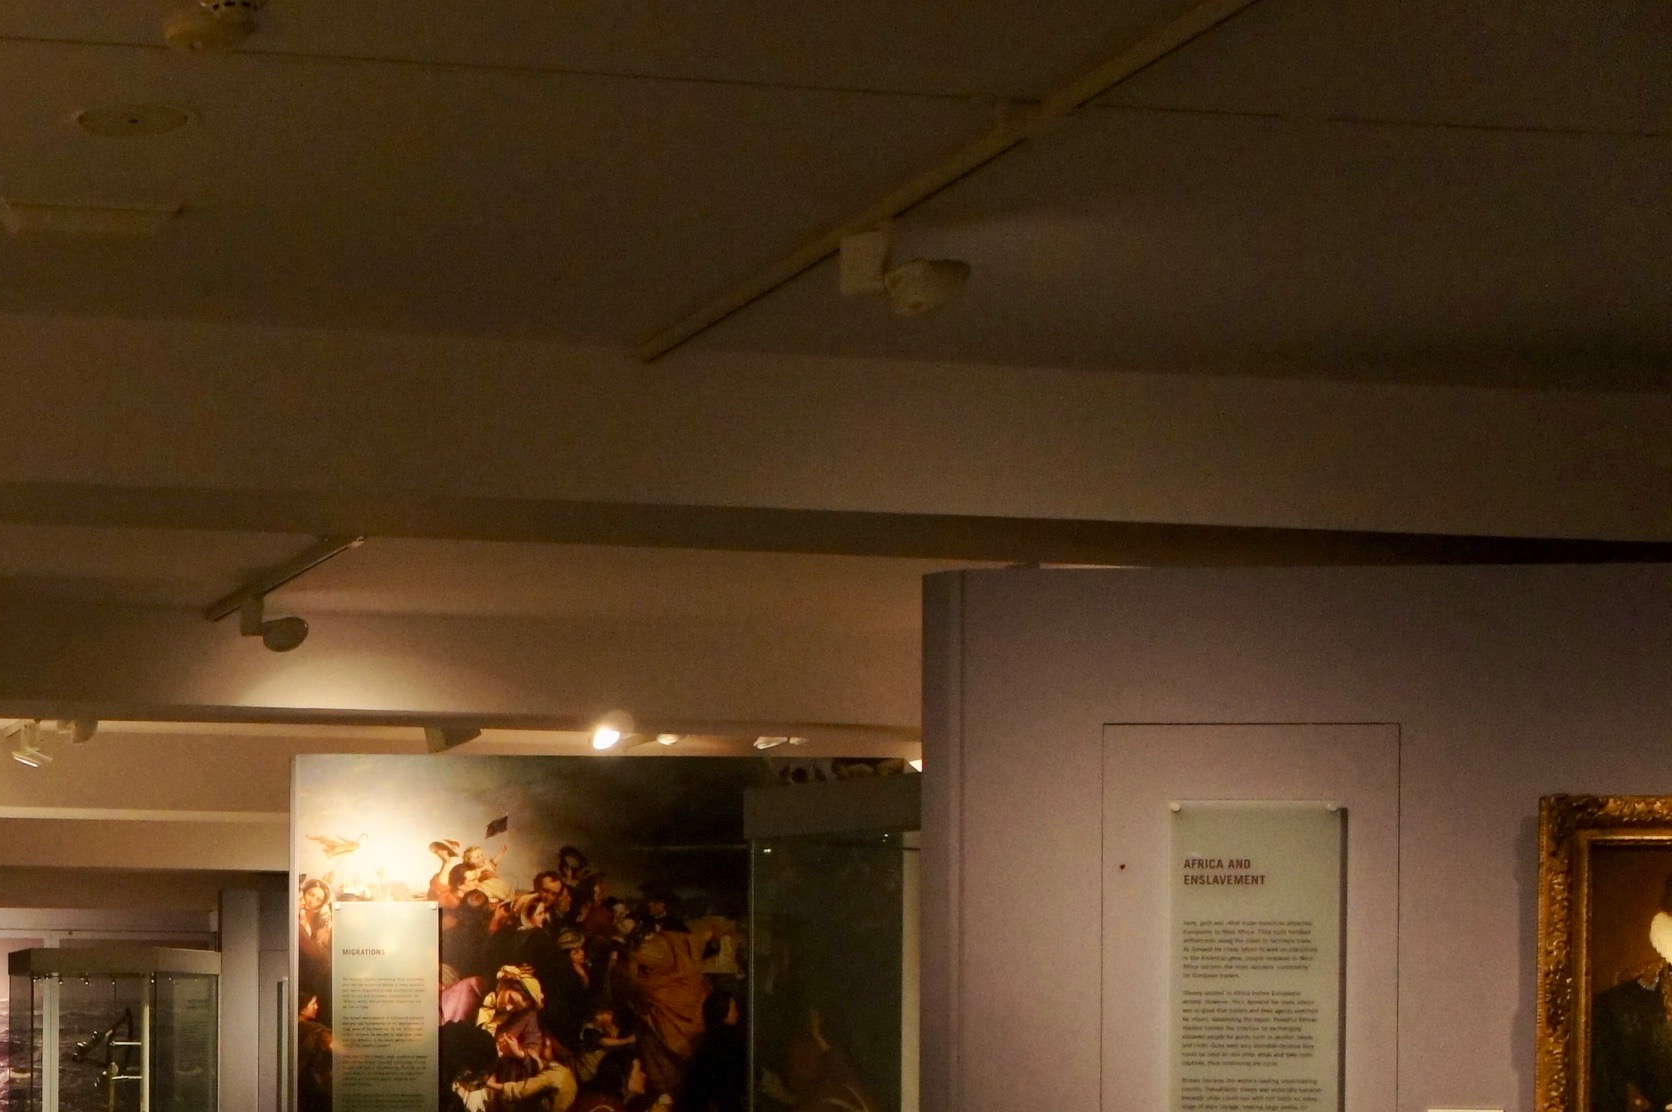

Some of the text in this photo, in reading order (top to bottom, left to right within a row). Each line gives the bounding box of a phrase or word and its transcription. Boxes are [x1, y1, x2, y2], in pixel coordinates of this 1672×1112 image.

[1184, 859, 1251, 869] AFRICA AND
[1184, 875, 1265, 885] ENSLAVEMENT
